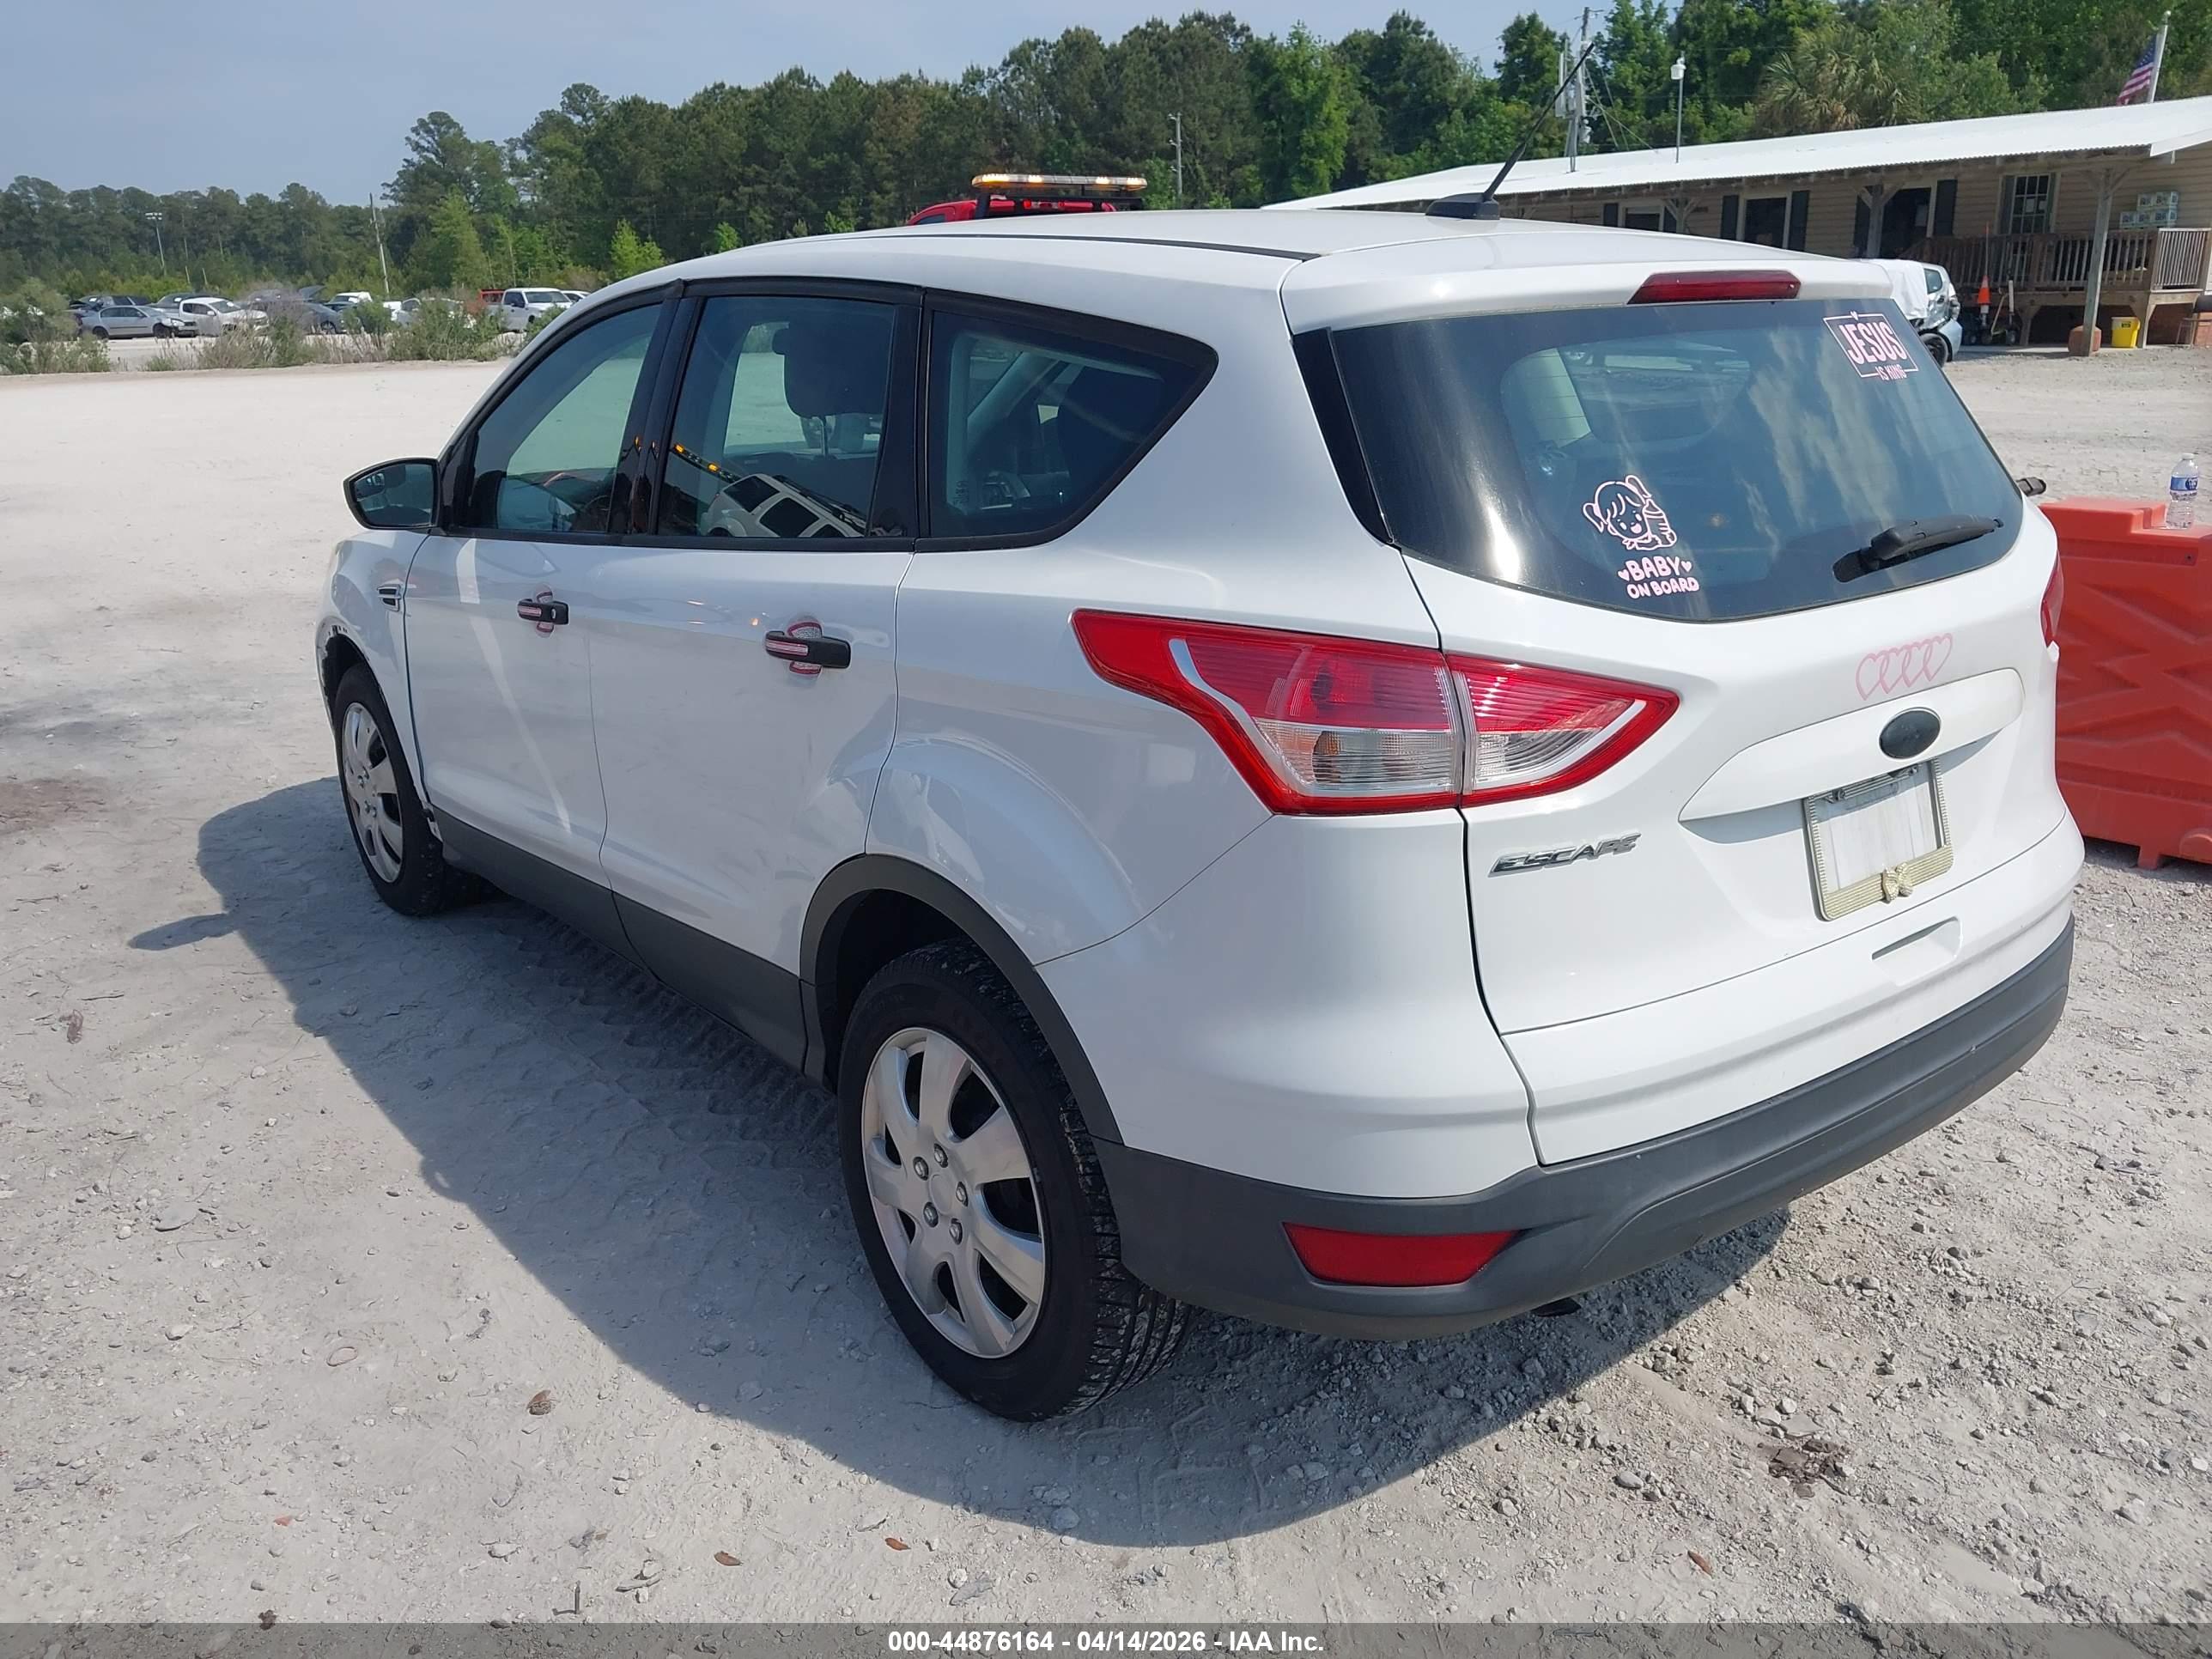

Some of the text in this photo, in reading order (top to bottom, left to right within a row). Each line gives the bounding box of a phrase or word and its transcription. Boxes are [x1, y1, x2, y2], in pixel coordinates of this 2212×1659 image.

[1838, 322, 1907, 364] JESUS
[1875, 364, 1907, 380] IS KING
[1626, 556, 1680, 581] BABY
[1627, 577, 1699, 599] ON BOARD
[1487, 833, 1641, 878] ESCAPE
